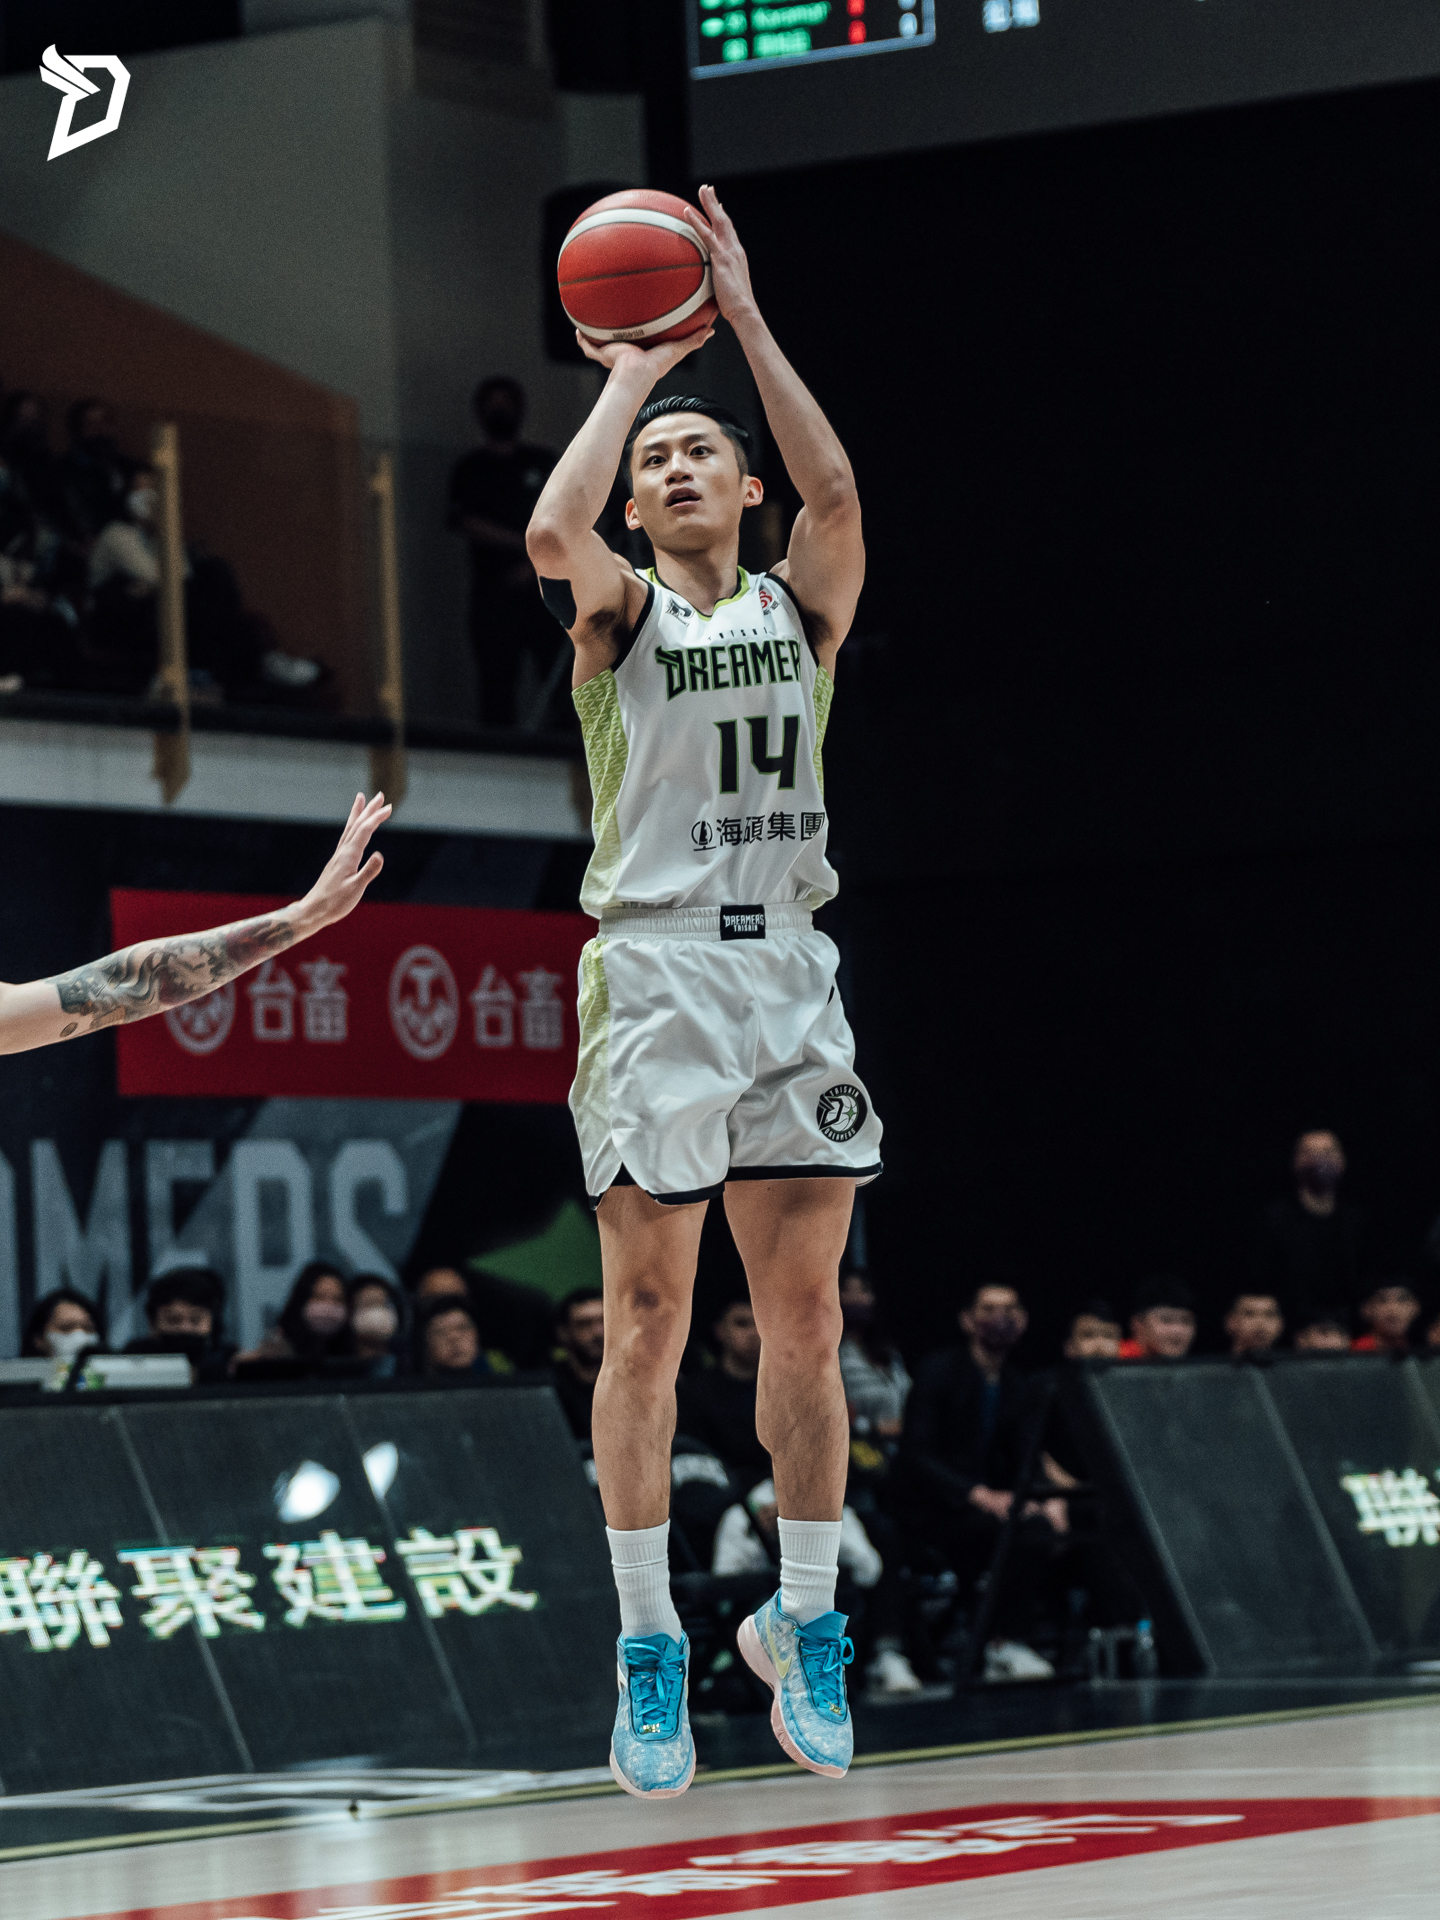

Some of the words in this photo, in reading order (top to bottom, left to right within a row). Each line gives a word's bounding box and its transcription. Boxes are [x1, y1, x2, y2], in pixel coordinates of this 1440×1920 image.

[713, 714, 801, 794] 14
[723, 914, 765, 928] DREAMERS
[0, 1138, 409, 1357] MERS
